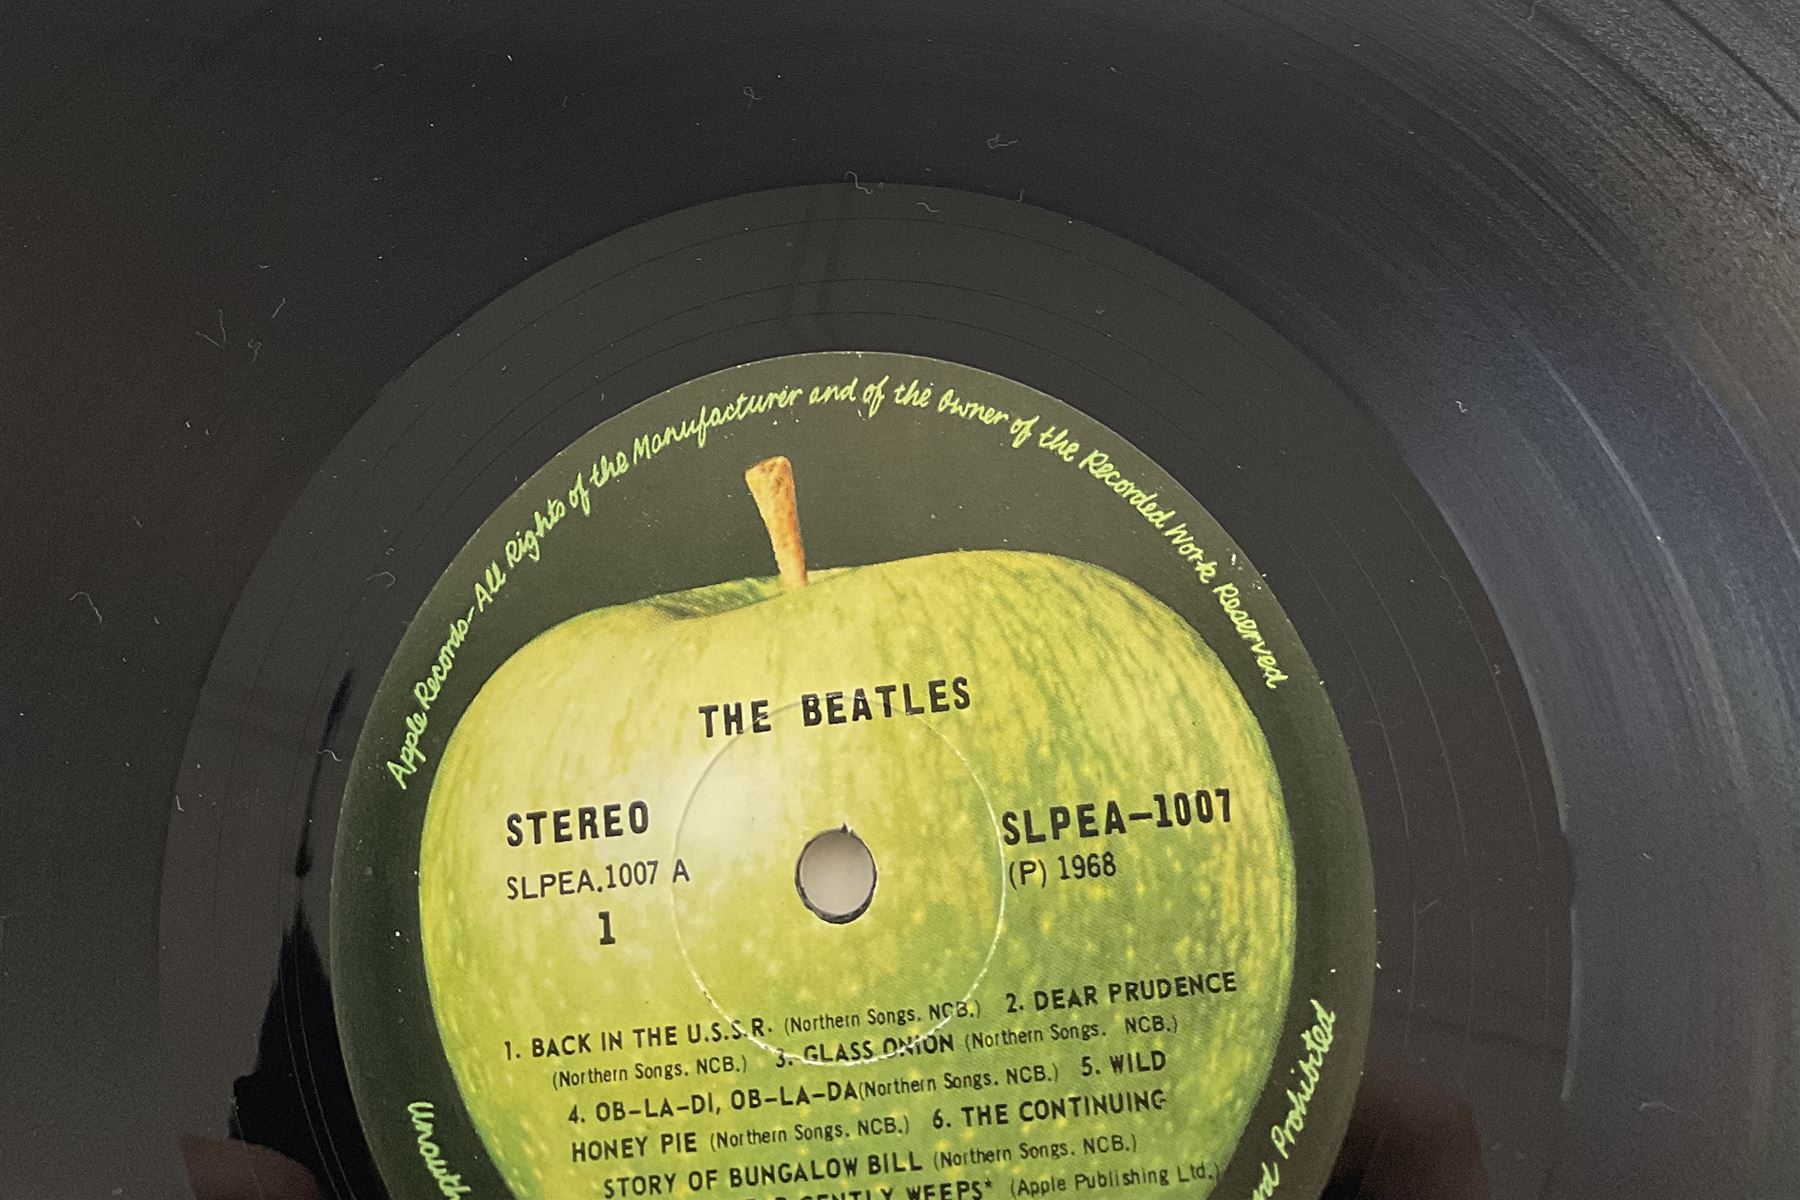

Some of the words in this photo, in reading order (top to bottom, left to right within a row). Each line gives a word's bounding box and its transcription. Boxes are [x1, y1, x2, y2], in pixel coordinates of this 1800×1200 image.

[387, 712, 428, 790] Apple
[475, 560, 506, 612] All
[505, 497, 566, 569] Rights
[568, 472, 591, 517] of
[589, 451, 629, 487] the
[633, 387, 803, 464] Manufacturer
[809, 377, 858, 404] and
[862, 375, 890, 418] of
[894, 379, 932, 408] the
[937, 389, 1009, 425] Owner
[1010, 415, 1040, 448] of
[1038, 426, 1080, 462] the
[1078, 450, 1176, 528] Recorded
[1164, 523, 1218, 584] Work
[1212, 583, 1289, 689] Reserved
[698, 699, 772, 739] THE
[801, 677, 971, 727] BEATLES
[506, 800, 650, 847] STEREO
[1001, 788, 1231, 845] SLPEA-1007
[506, 860, 659, 900] SLPEA.1007
[672, 858, 690, 883] A
[1008, 860, 1048, 890] (P)
[1058, 851, 1117, 880] 1968
[599, 911, 616, 945] 1
[504, 1041, 521, 1061] 1.
[531, 1033, 592, 1058] BACK
[601, 1030, 623, 1052] IN
[632, 1026, 678, 1049] THE
[687, 1017, 773, 1044] U.S.S.R.
[784, 1013, 861, 1037] (Northern
[928, 1000, 982, 1020] NCB.)
[1006, 993, 1025, 1014] 2.
[1034, 984, 1098, 1012] DEAR
[1109, 971, 1237, 1004] PRUDENCE
[552, 1068, 628, 1091] (Northern
[696, 1054, 748, 1075] NCB.)
[775, 1048, 793, 1068] 3.
[803, 1040, 874, 1065] GLASS
[883, 1034, 954, 1058] ONION
[965, 1026, 1043, 1052] (Northern
[1124, 1014, 1179, 1035] NCB.)
[567, 1104, 586, 1125] 4.
[595, 1092, 721, 1122] OB-LA-DI,
[1006, 1063, 1059, 1085] NCB.)
[1081, 1055, 1101, 1077] 5.
[1109, 1050, 1167, 1075] WILD
[1251, 1161, 1280, 1200] nd
[1270, 998, 1336, 1160] Prohibited
[571, 1135, 648, 1163] HONEY
[660, 1131, 697, 1154] PIE
[710, 1126, 787, 1153] (Northern
[857, 1116, 910, 1137] NCB.)
[932, 1108, 951, 1130] 6.
[961, 1102, 1009, 1128] THE
[1018, 1088, 1166, 1122] CONTINUING
[603, 1172, 677, 1199] STORY
[688, 1169, 718, 1192] OF
[729, 1156, 858, 1188] BUNGALOW
[867, 1151, 923, 1176] BILL
[933, 1145, 1012, 1171] (Northern
[1083, 1133, 1137, 1154] NCB.)
[1010, 1174, 1067, 1199] (Apple
[1074, 1167, 1169, 1191] Publishing
[1176, 1162, 1221, 1188] Ltd.)
